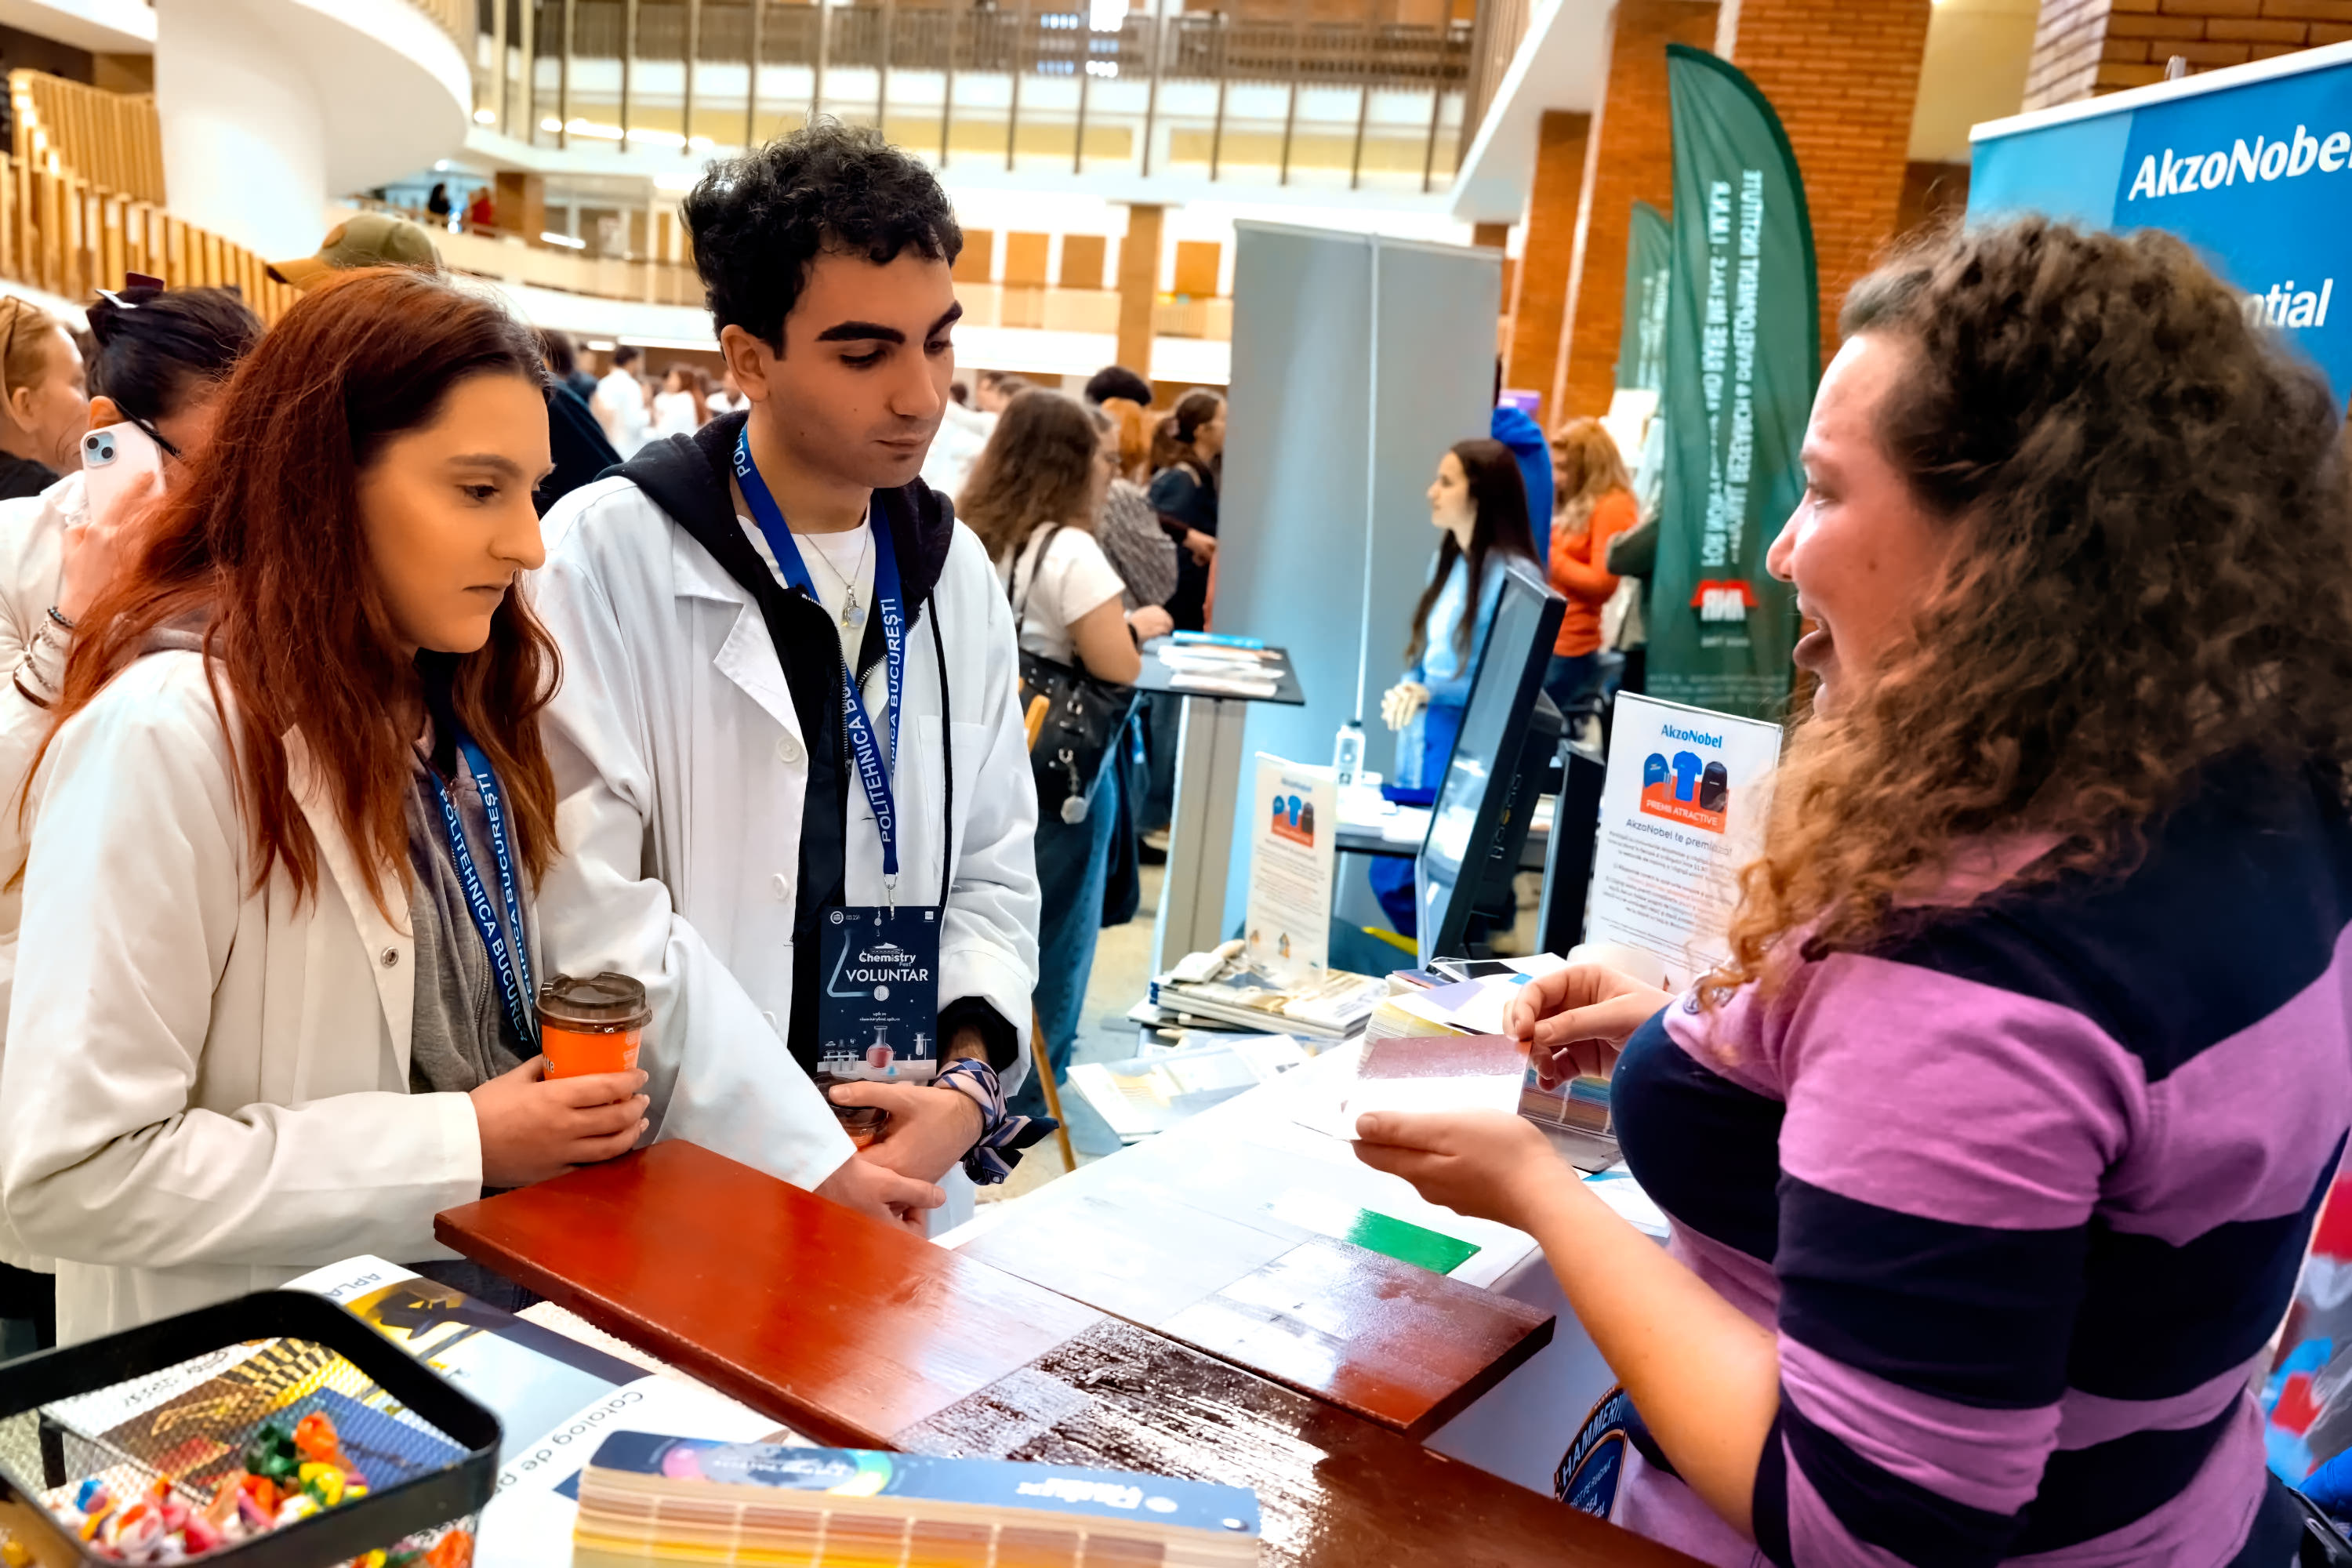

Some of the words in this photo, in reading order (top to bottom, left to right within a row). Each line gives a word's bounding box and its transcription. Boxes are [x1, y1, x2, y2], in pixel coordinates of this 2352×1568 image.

[2128, 124, 2352, 201] AkzoNobe
[2243, 278, 2334, 328] ntial
[880, 598, 905, 708] BUCUREȘTI
[1661, 724, 1722, 749] AkzoNobel
[848, 715, 891, 843] POLITEHNICA
[476, 773, 514, 904] BUCUREȘTI
[1626, 818, 1673, 841] AkzoNobel
[1675, 831, 1684, 844] te
[1674, 807, 1719, 826] ATRACTIVE
[440, 789, 496, 938] POLITEHNICA
[846, 969, 928, 982] VOLUNTAR
[859, 949, 916, 964] Chemistry
[552, 1391, 644, 1445] Catalog
[521, 1449, 552, 1471] de
